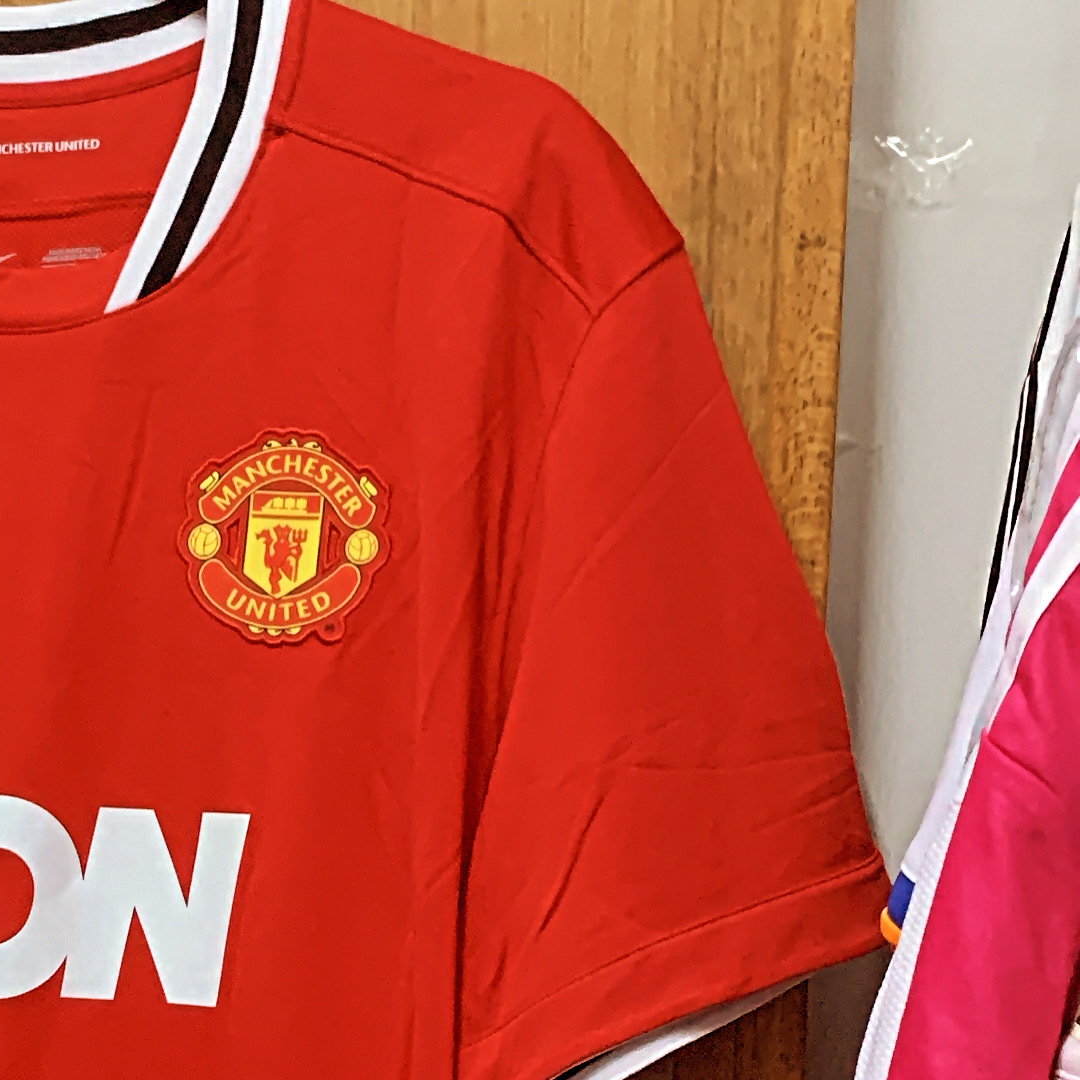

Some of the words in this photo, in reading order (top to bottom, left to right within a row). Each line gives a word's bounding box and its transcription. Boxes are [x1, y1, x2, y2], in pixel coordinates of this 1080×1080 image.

[54, 138, 101, 153] UNITED
[212, 453, 364, 518] MANCHESTER
[225, 588, 331, 622] UNITED
